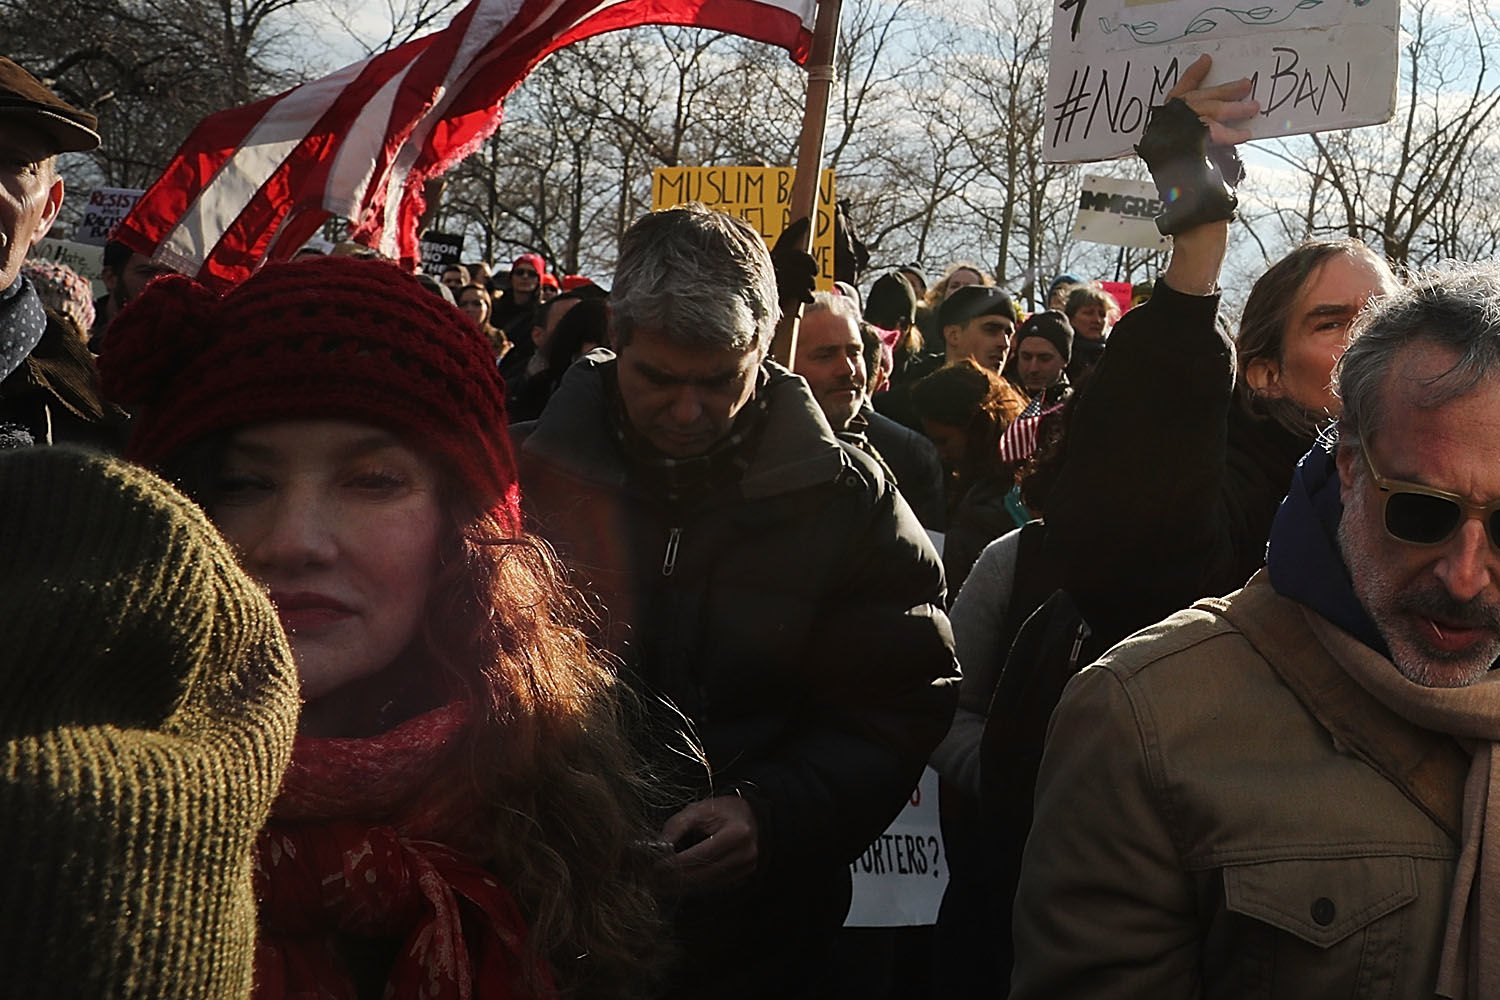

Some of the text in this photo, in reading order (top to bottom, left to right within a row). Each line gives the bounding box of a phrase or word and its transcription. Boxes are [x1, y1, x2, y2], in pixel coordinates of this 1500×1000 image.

[89, 191, 141, 208] RESIST
[659, 171, 833, 206] MUSLIM BN
[1079, 190, 1163, 219] IMMIGRE
[420, 241, 459, 255] EROR
[853, 834, 940, 878] ORTERS?
